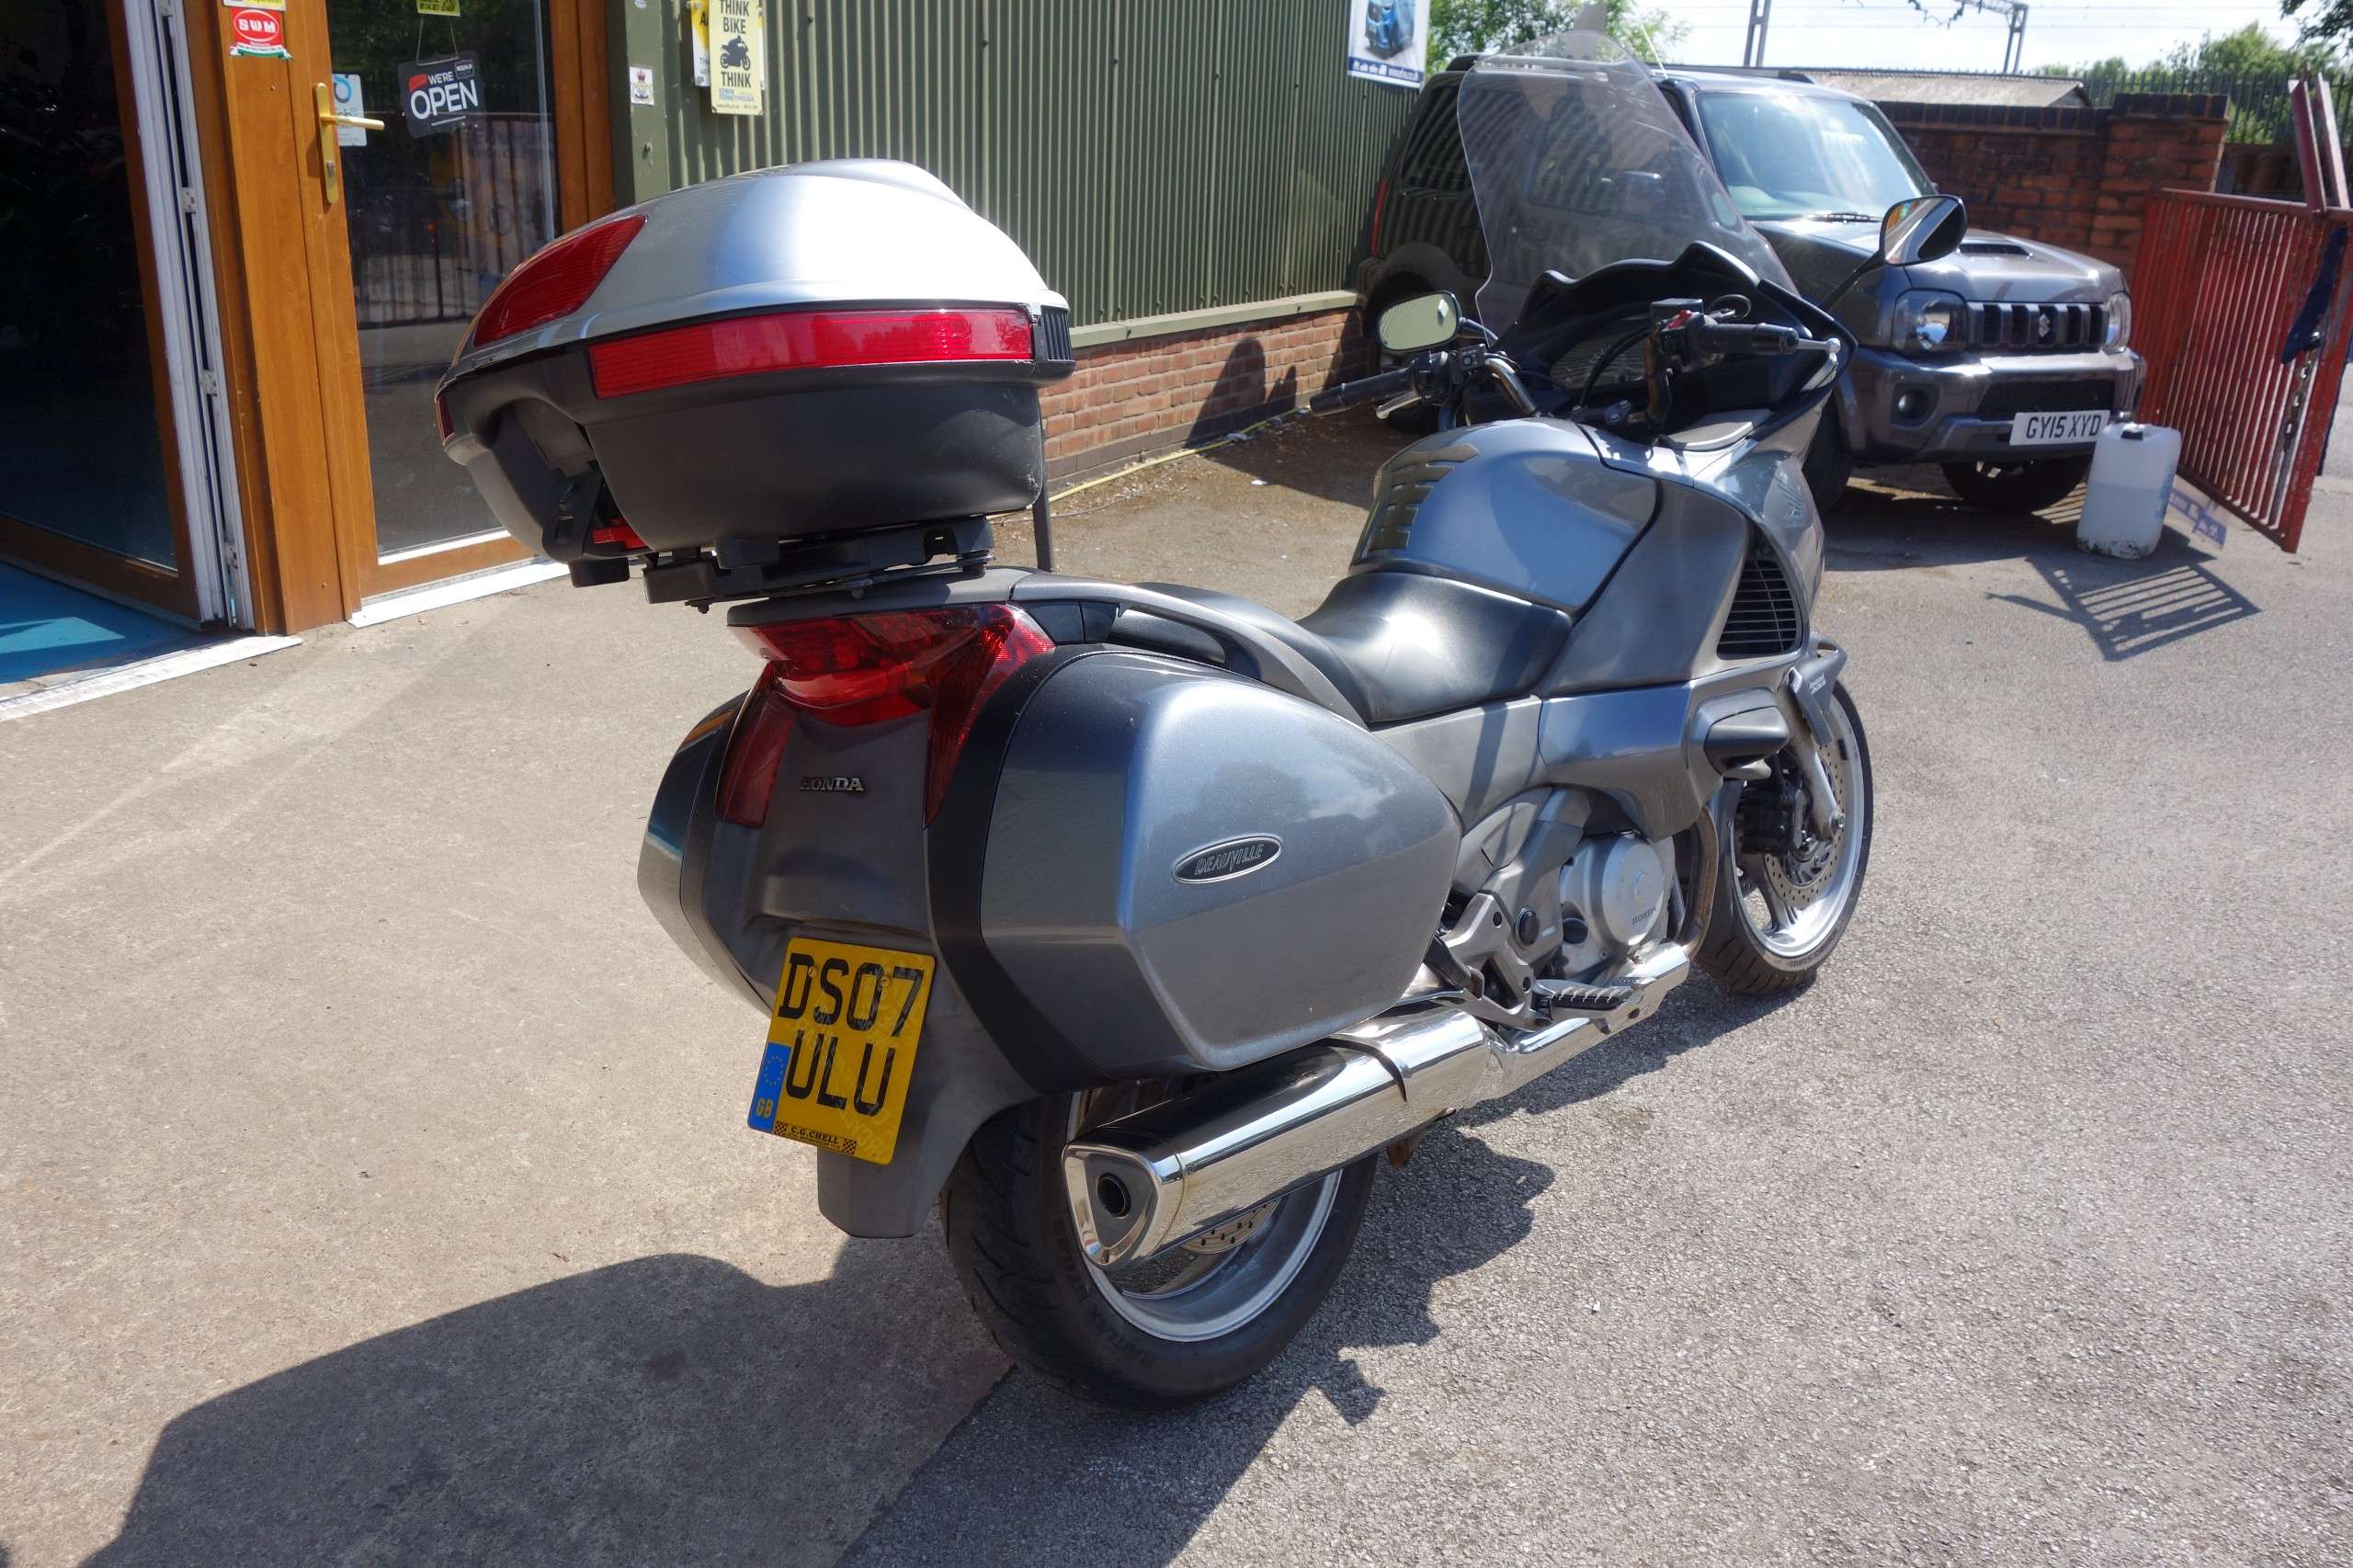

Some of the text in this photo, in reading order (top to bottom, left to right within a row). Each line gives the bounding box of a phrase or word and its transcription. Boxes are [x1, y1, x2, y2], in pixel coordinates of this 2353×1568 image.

[720, 0, 750, 17] THINK
[723, 17, 746, 34] BIKE
[721, 72, 751, 88] THINK
[411, 79, 478, 119] OPEN
[2026, 415, 2102, 438] GY15 XYD
[1195, 843, 1264, 875] DEAUVILLE
[778, 952, 925, 1038] DS07
[785, 1028, 896, 1117] ULU
[756, 1097, 773, 1119] GB
